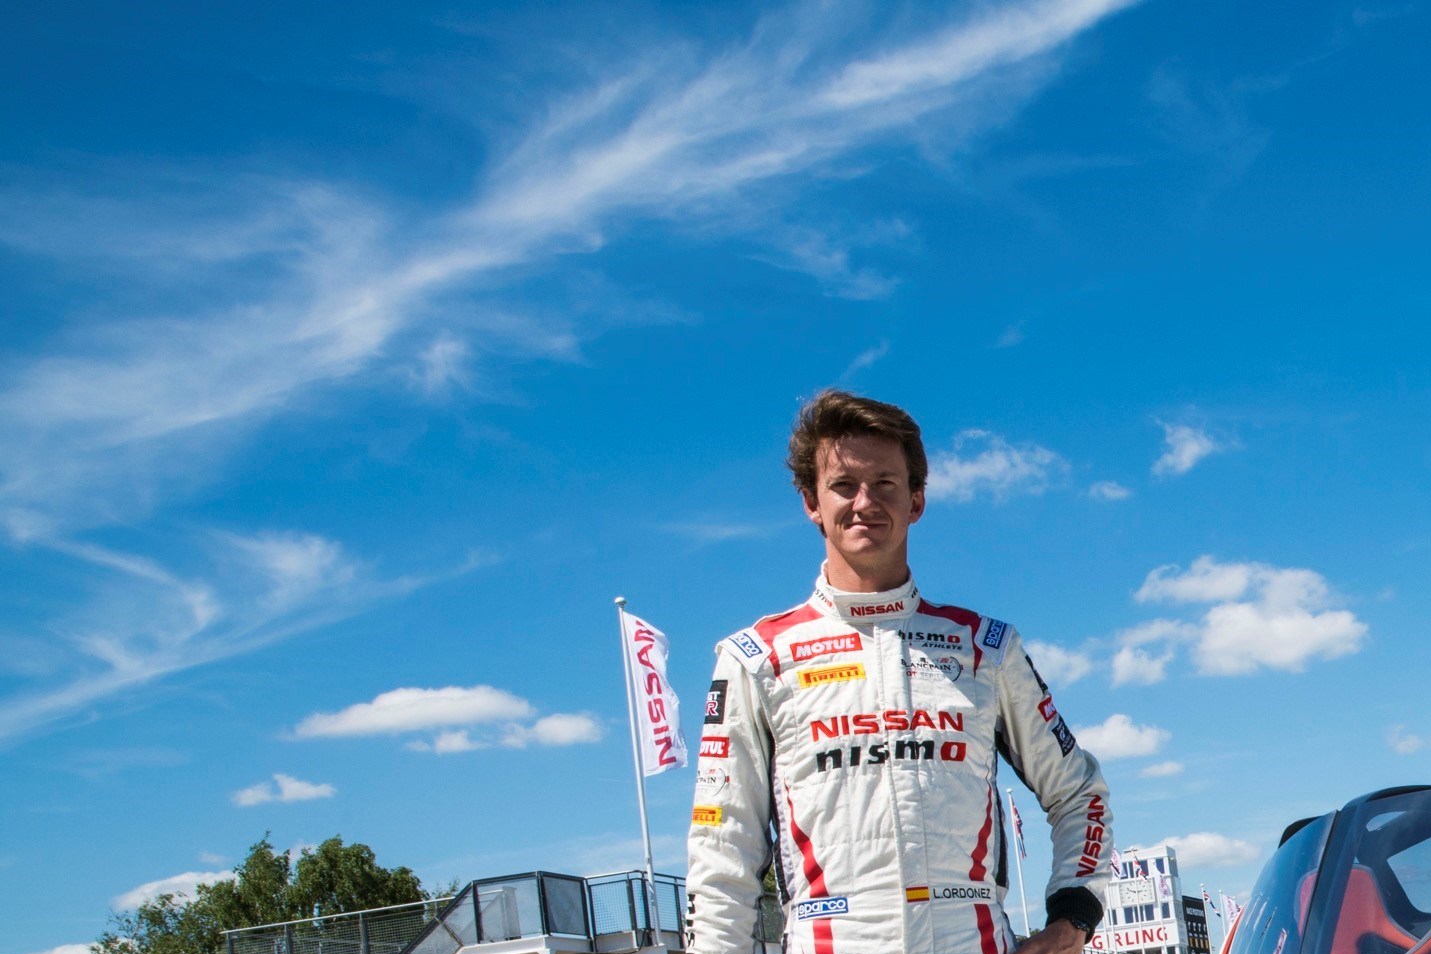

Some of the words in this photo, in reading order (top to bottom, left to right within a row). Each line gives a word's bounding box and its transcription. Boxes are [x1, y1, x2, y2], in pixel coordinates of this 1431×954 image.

[850, 601, 904, 616] NISSAN
[898, 629, 961, 644] nismo
[796, 637, 856, 659] MOTUL
[922, 642, 963, 651] ATHLETE
[900, 658, 952, 672] BLANCPAIN
[803, 665, 860, 687] PIRELLI
[634, 620, 678, 767] NISSAN
[810, 709, 964, 742] NISSAN
[700, 741, 726, 755] OTUL
[816, 740, 967, 772] nismo
[1075, 794, 1106, 878] NISSAN
[933, 888, 991, 900] L.ORDONEZ
[798, 898, 847, 917] sparco
